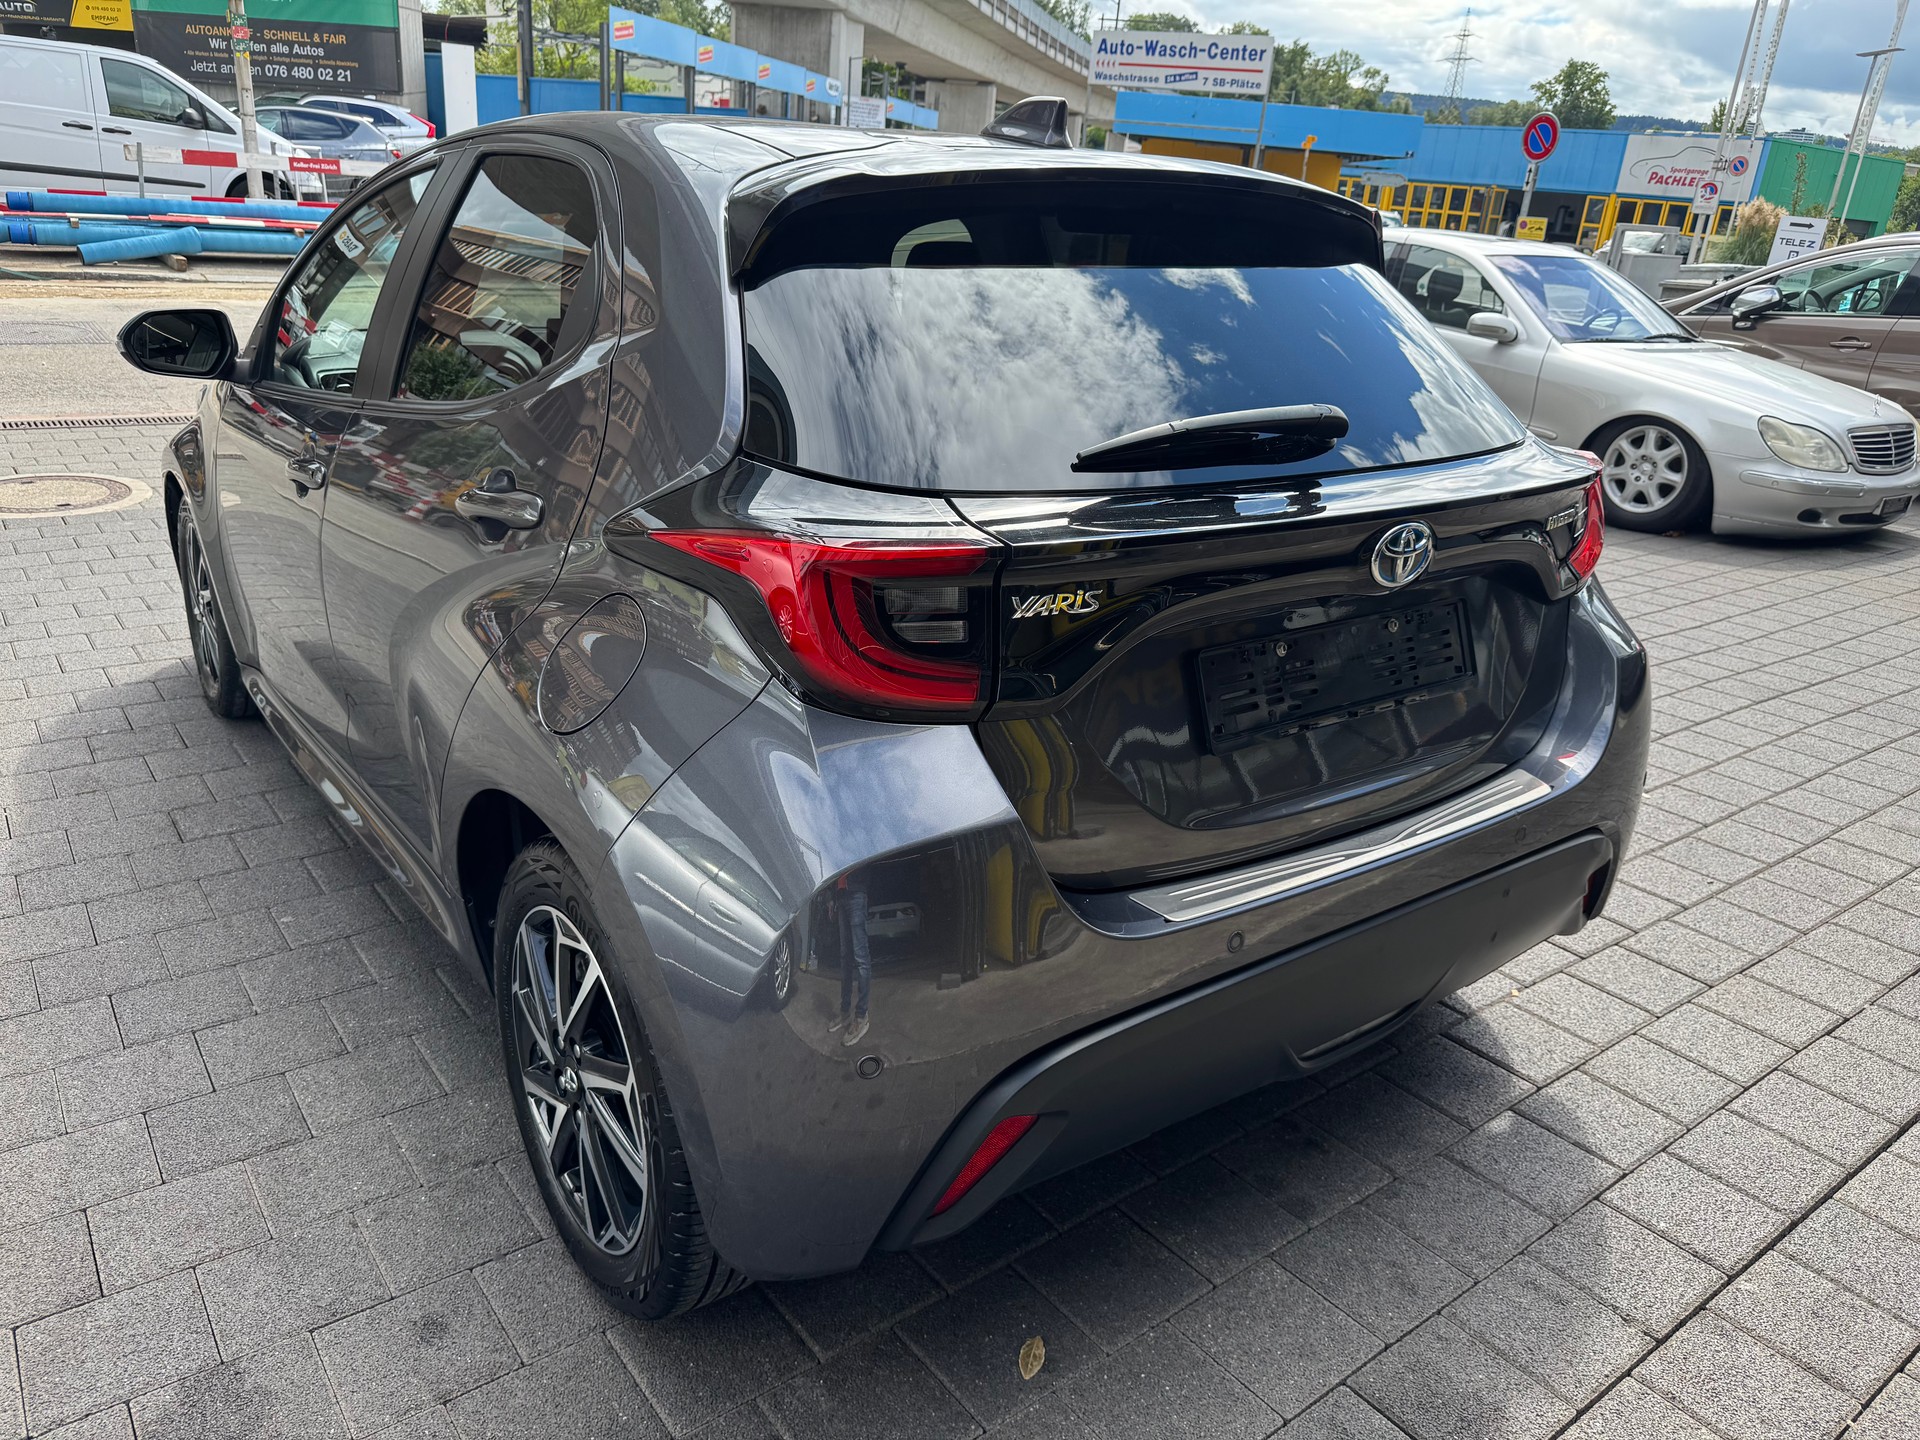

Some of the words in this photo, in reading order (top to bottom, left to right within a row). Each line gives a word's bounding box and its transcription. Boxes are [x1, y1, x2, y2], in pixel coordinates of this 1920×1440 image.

[185, 24, 253, 37] AUTOANKF
[263, 29, 311, 42] SCHNELL
[313, 33, 321, 43] &
[323, 33, 347, 45] FAIR
[208, 38, 227, 50] Wir
[270, 42, 289, 54] alle
[292, 43, 325, 56] Autos
[1097, 38, 1267, 61] Auto-Wasch-Center
[190, 59, 217, 73] Jetzt
[265, 64, 288, 77] 076
[291, 65, 314, 80] 480
[317, 67, 333, 81] 02
[337, 69, 351, 82] 21
[1094, 71, 1160, 84] Waschstrasse
[1202, 77, 1209, 86] 7
[1212, 78, 1262, 90] SB-Plätze
[1647, 171, 1701, 188] PACHLE
[1669, 166, 1710, 177] Sportgarage
